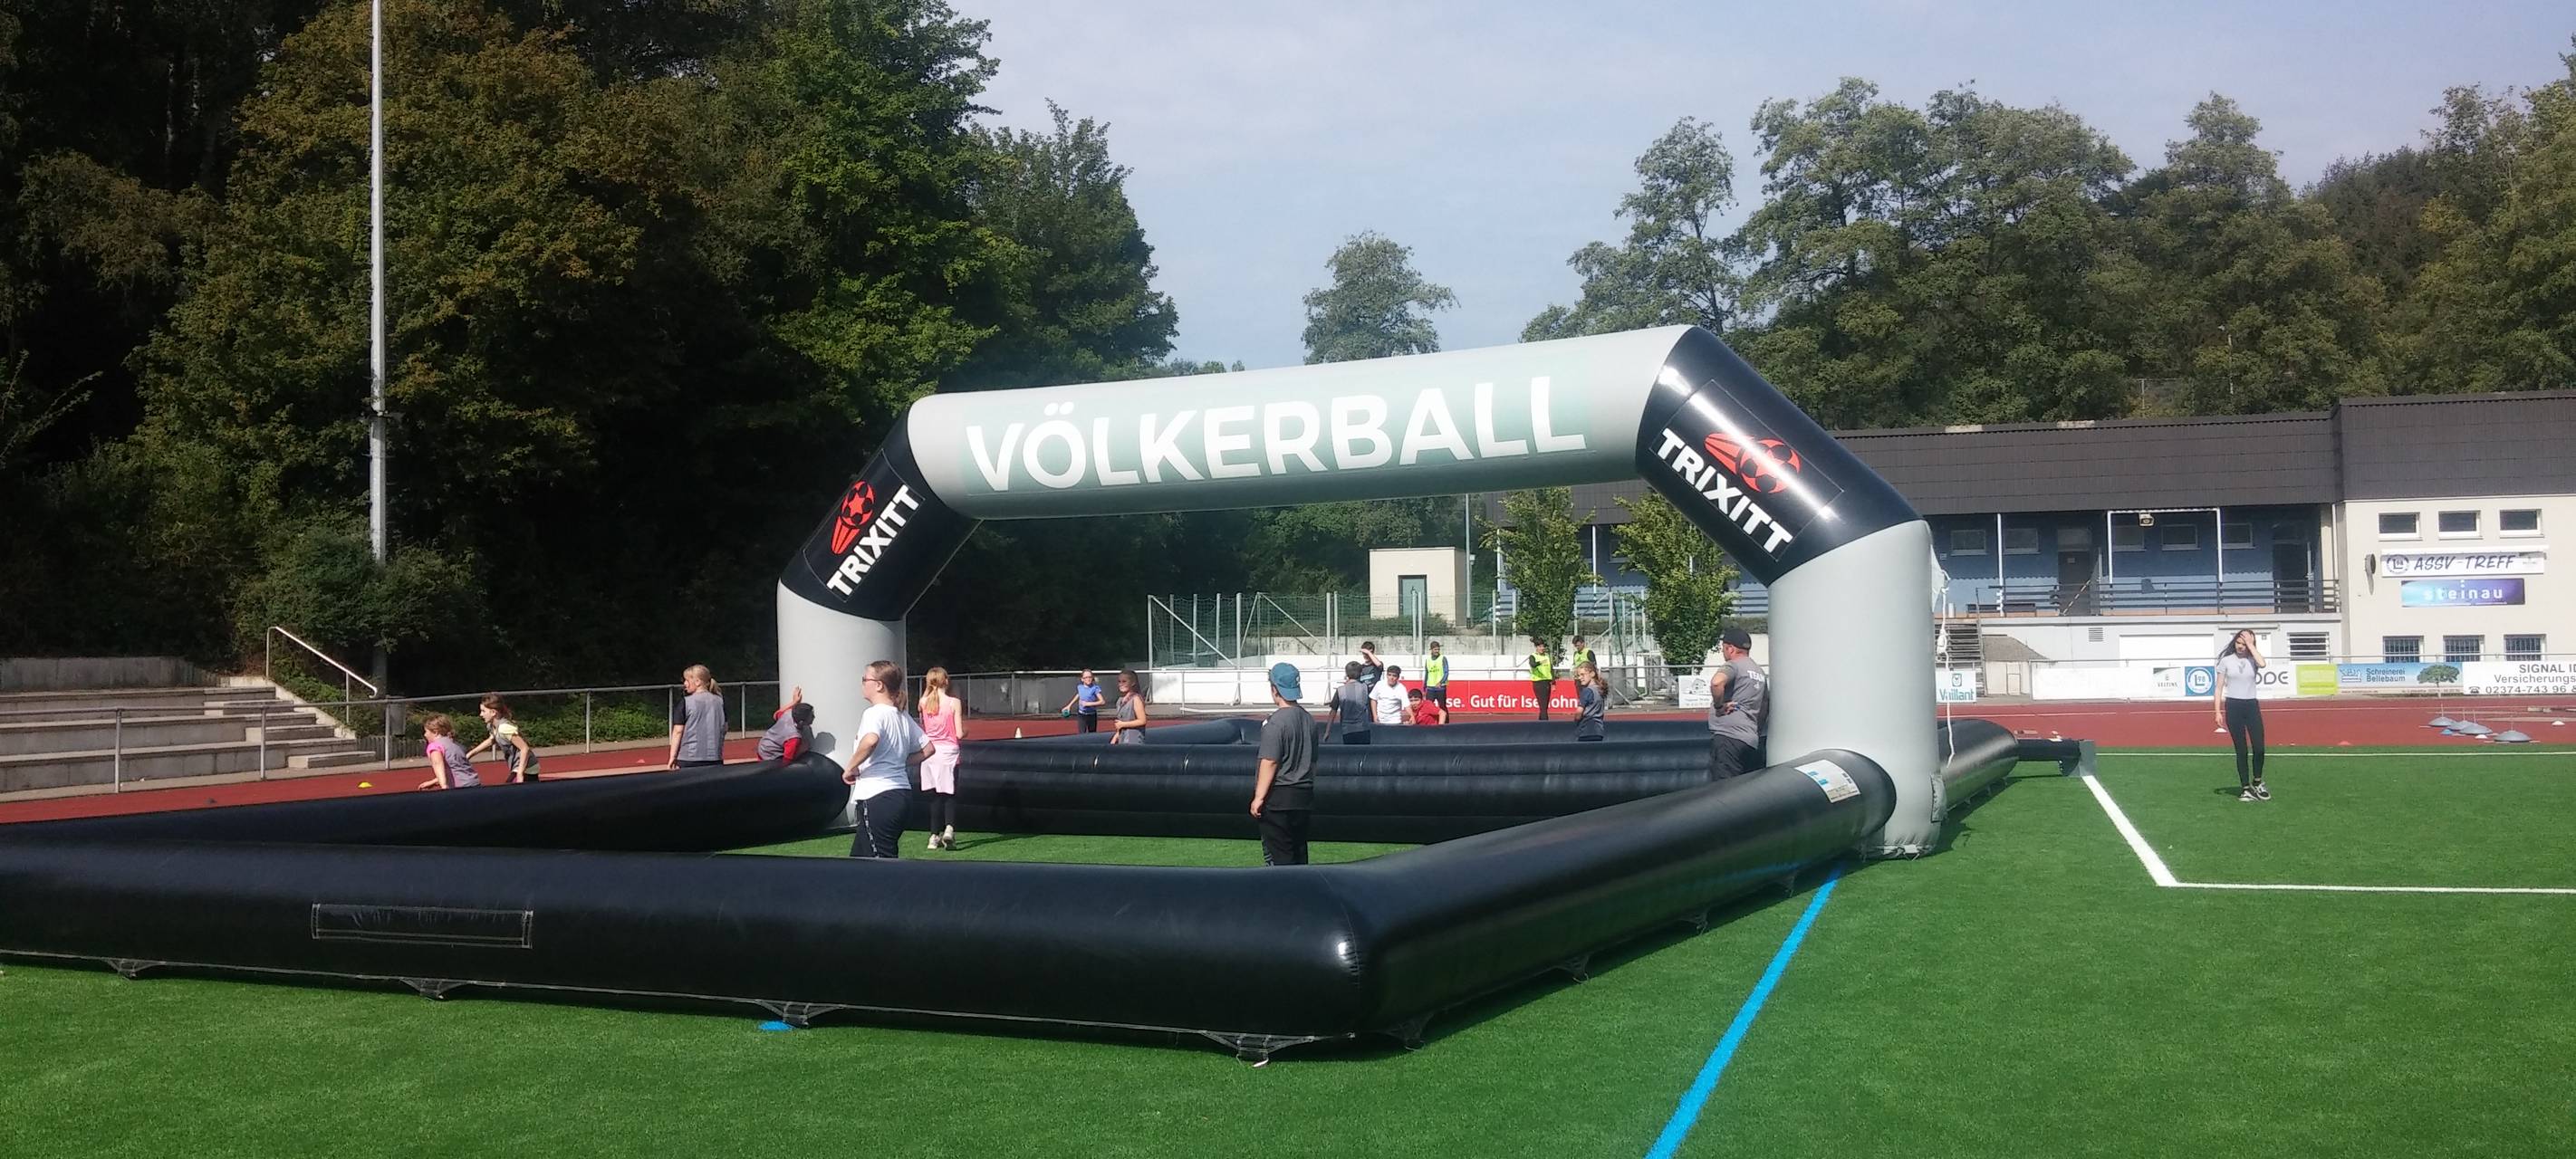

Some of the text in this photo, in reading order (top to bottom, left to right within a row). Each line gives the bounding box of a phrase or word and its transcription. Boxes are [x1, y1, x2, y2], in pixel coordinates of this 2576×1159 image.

[966, 376, 1587, 492] VÖLKERBALL
[1658, 427, 1793, 553] TRIXITT
[826, 484, 919, 596] TRIXITT
[2423, 580, 2504, 599] steinau
[2366, 667, 2406, 675] Schreinerei
[2519, 664, 2565, 674] SIGNAL
[2485, 685, 2548, 694] 02374-743
[2552, 685, 2567, 694] 96
[1470, 694, 1495, 709] Gut
[1497, 694, 1518, 709] für
[1521, 694, 1578, 708] Iseohn
